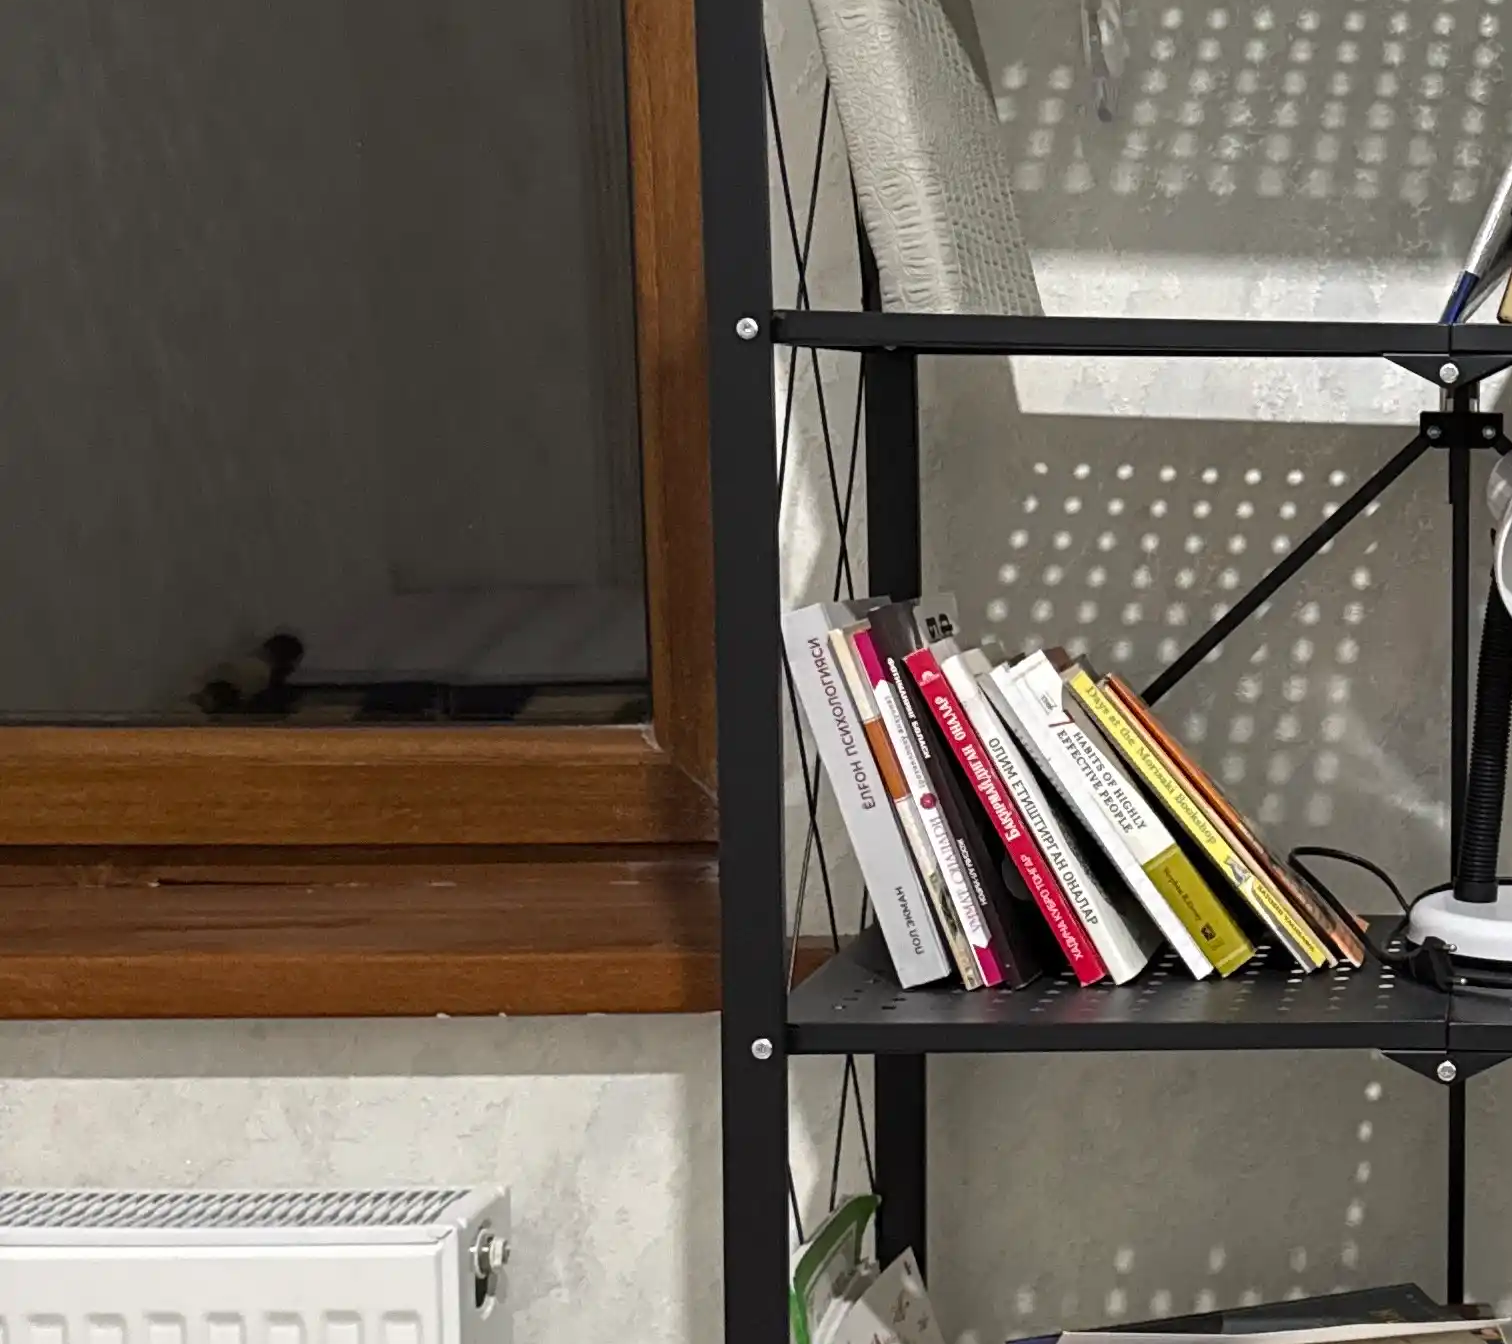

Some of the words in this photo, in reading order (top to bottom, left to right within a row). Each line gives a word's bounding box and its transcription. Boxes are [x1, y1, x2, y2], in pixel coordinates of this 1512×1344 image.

[806, 636, 859, 757] ПСИХОЛОГИЯСИ
[932, 693, 967, 742] ОНАЛАР
[1083, 684, 1113, 717] Days
[1107, 712, 1123, 728] at
[1117, 725, 1139, 747] the
[910, 720, 931, 760] БОЛАСИ
[1045, 707, 1076, 735] 7
[1072, 729, 1106, 773] HABITS
[1100, 769, 1118, 789] OF
[1111, 786, 1147, 832] HIGHLY
[1056, 728, 1104, 791] EFFECTIVE
[1098, 787, 1134, 834] PEOPLE
[986, 735, 1018, 780] ОЛИМ
[1010, 778, 1068, 872] ЕТИШТИРГАН
[1060, 870, 1099, 928] ОНАЛАР
[892, 885, 916, 929] ЭКМАН
[1038, 888, 1062, 922] КУБРО
[908, 928, 925, 955] ПОЛ
